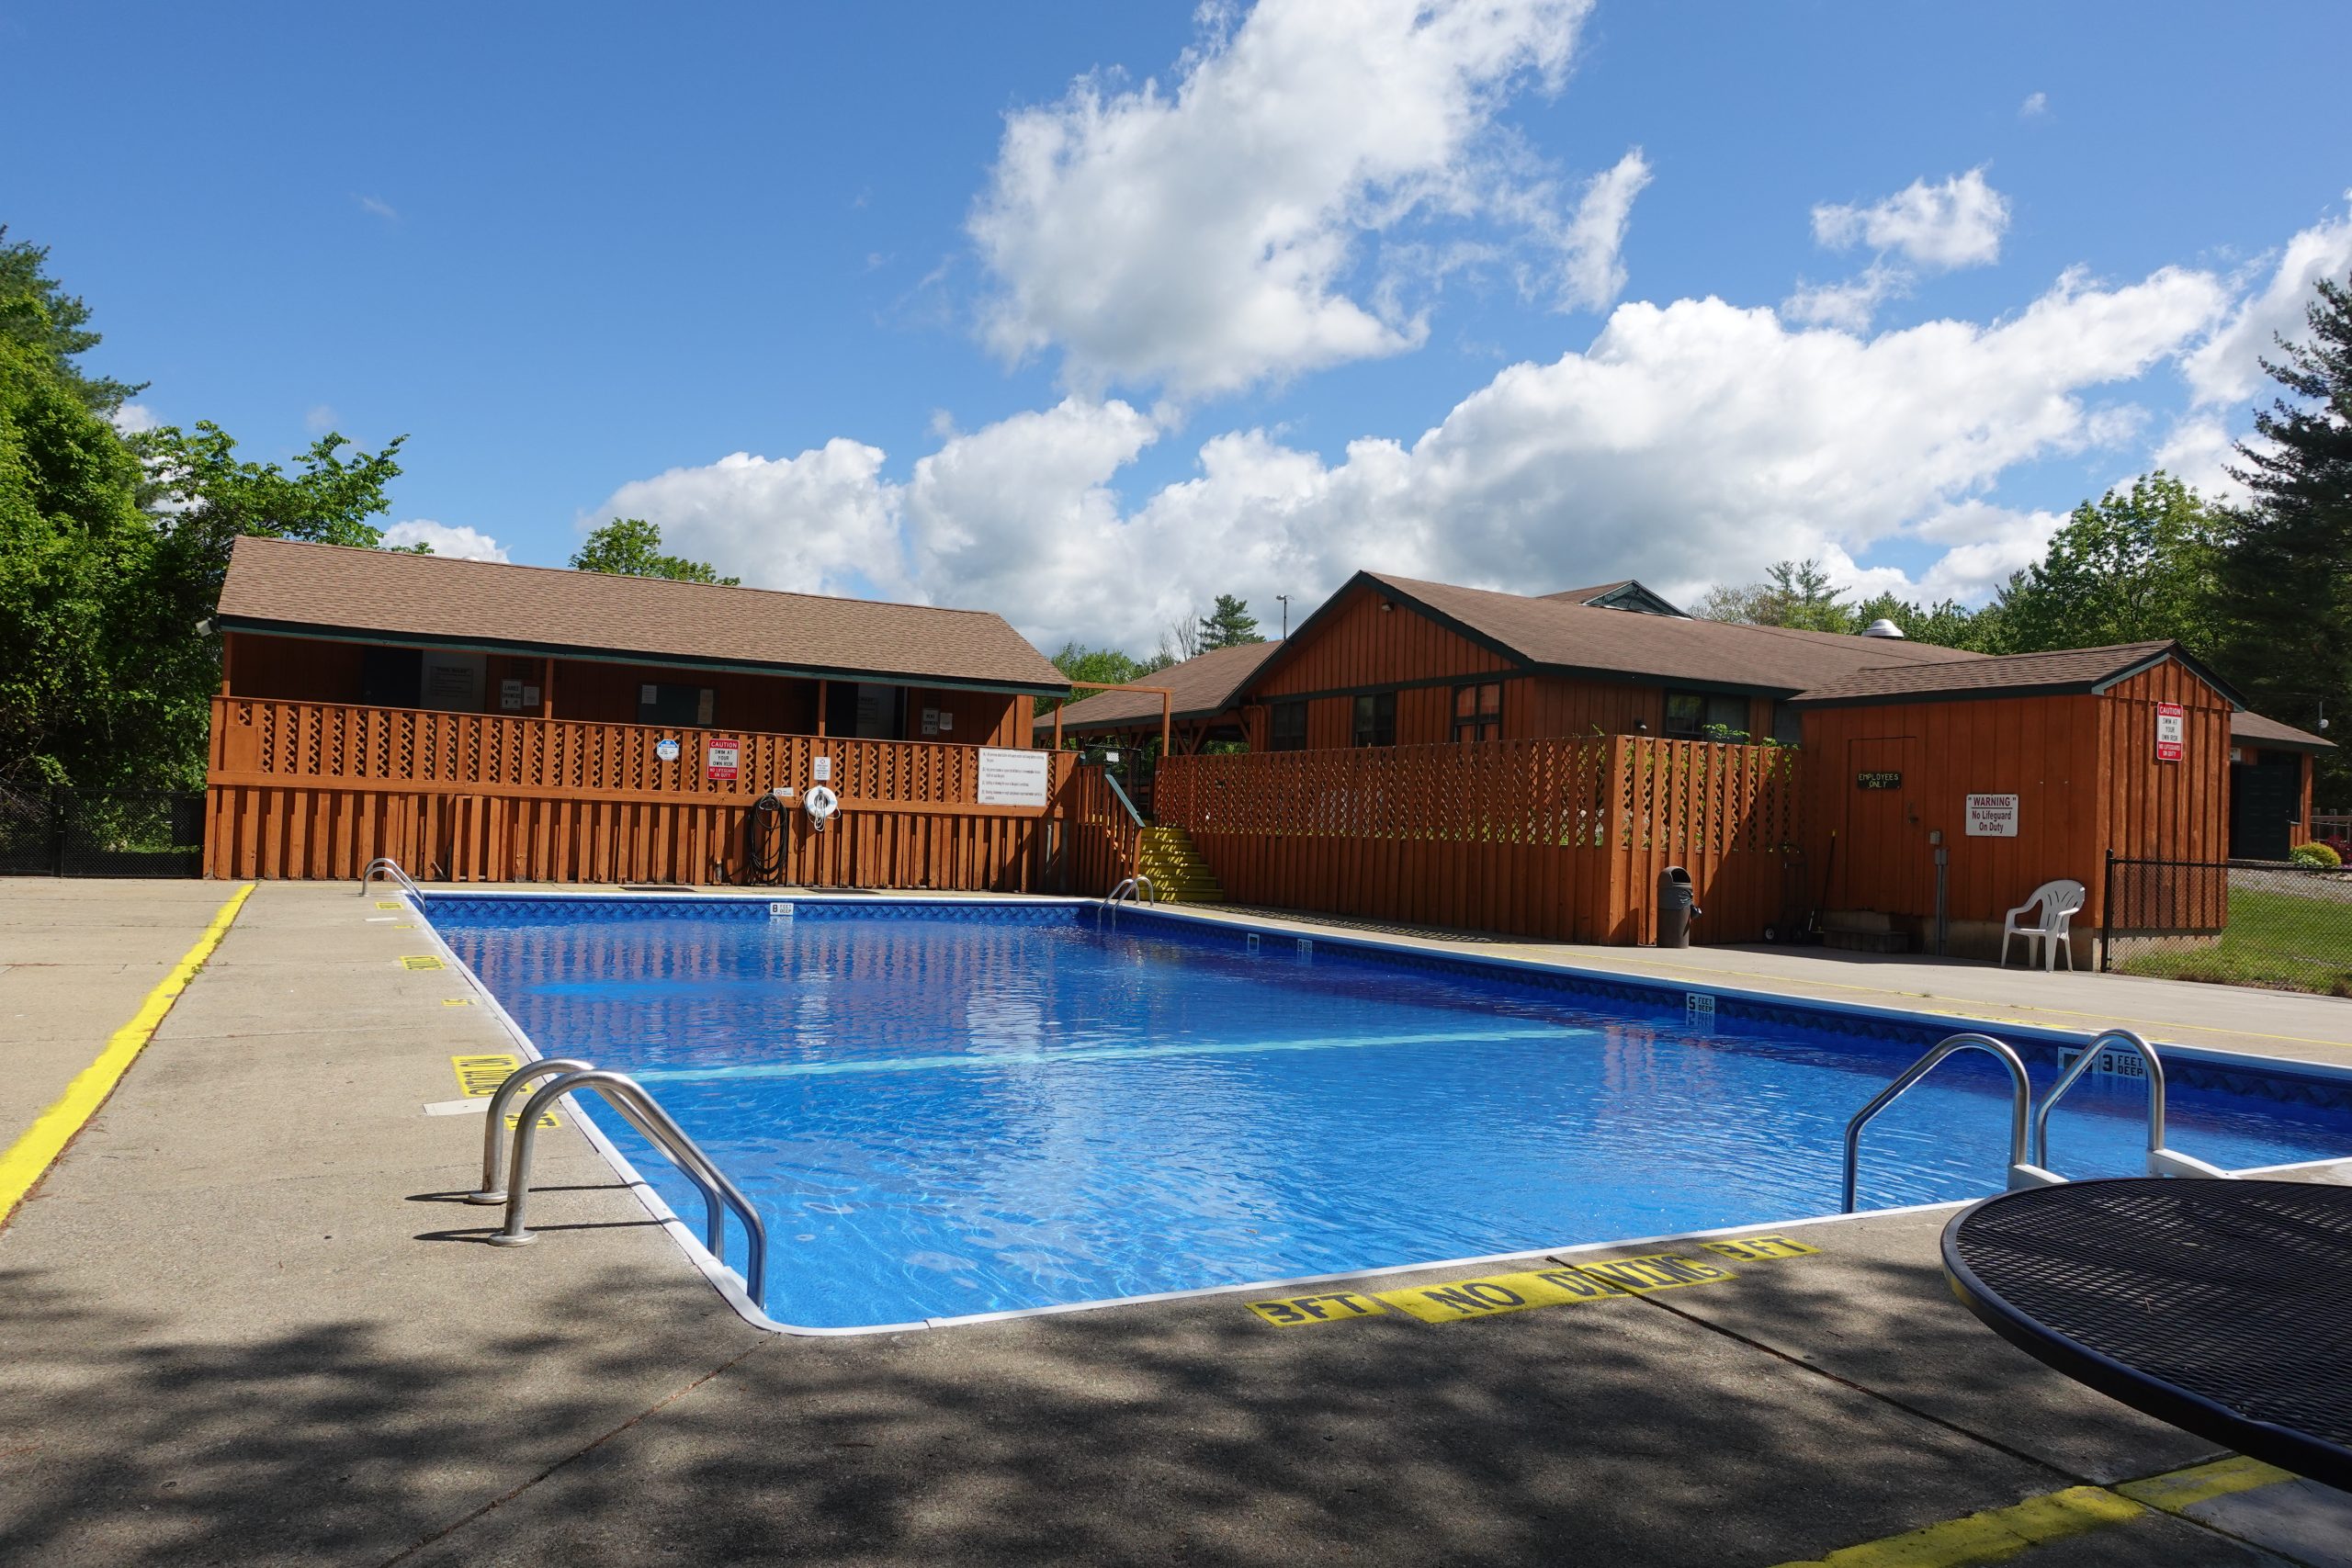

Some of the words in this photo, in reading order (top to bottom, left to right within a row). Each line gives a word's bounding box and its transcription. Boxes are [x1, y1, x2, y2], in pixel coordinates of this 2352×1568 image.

[2160, 706, 2181, 715] CAUTION
[1973, 810, 1980, 819] No
[1983, 810, 2011, 822] Lifeguard
[1979, 822, 1987, 830] On
[1990, 822, 2003, 833] Duty
[773, 904, 777, 912] 8
[2102, 1055, 2112, 1072] 3
[2118, 1055, 2143, 1066] FEET
[2118, 1066, 2143, 1077] DEEP
[1421, 1282, 1525, 1314] NO
[1538, 1254, 1726, 1296] DIVING
[1257, 1293, 1367, 1323] 3FT
